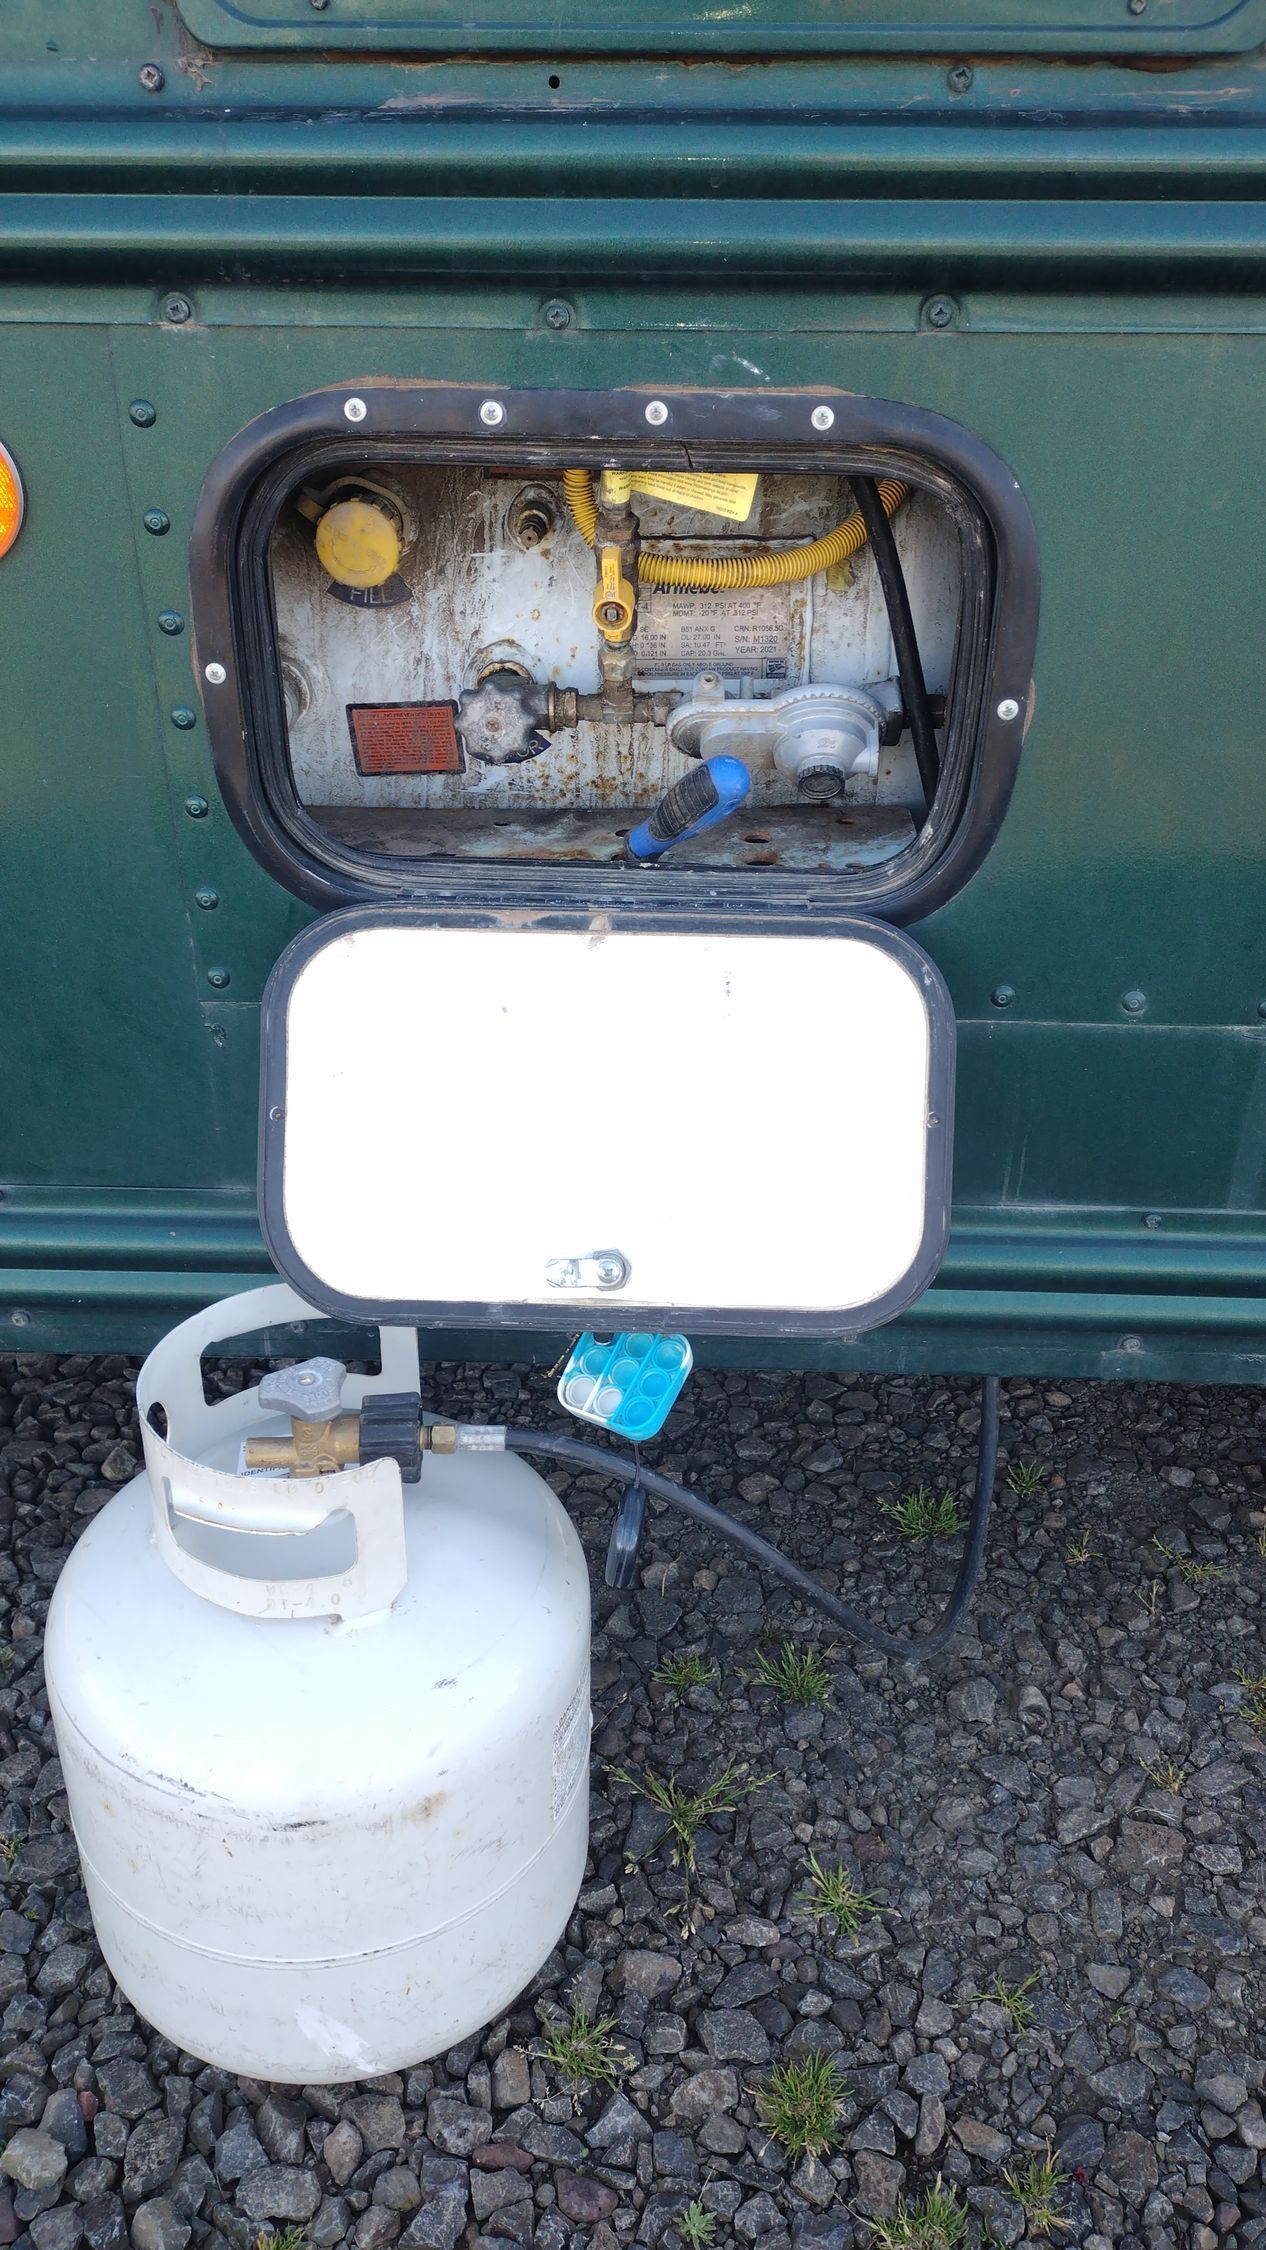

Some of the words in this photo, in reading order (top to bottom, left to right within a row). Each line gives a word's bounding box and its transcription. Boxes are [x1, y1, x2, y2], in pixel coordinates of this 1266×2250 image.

[350, 586, 393, 604] FILL
[734, 635, 751, 643] S/N:
[753, 635, 778, 644] M1320
[735, 646, 759, 654] YEAR:
[759, 645, 777, 653] 2021
